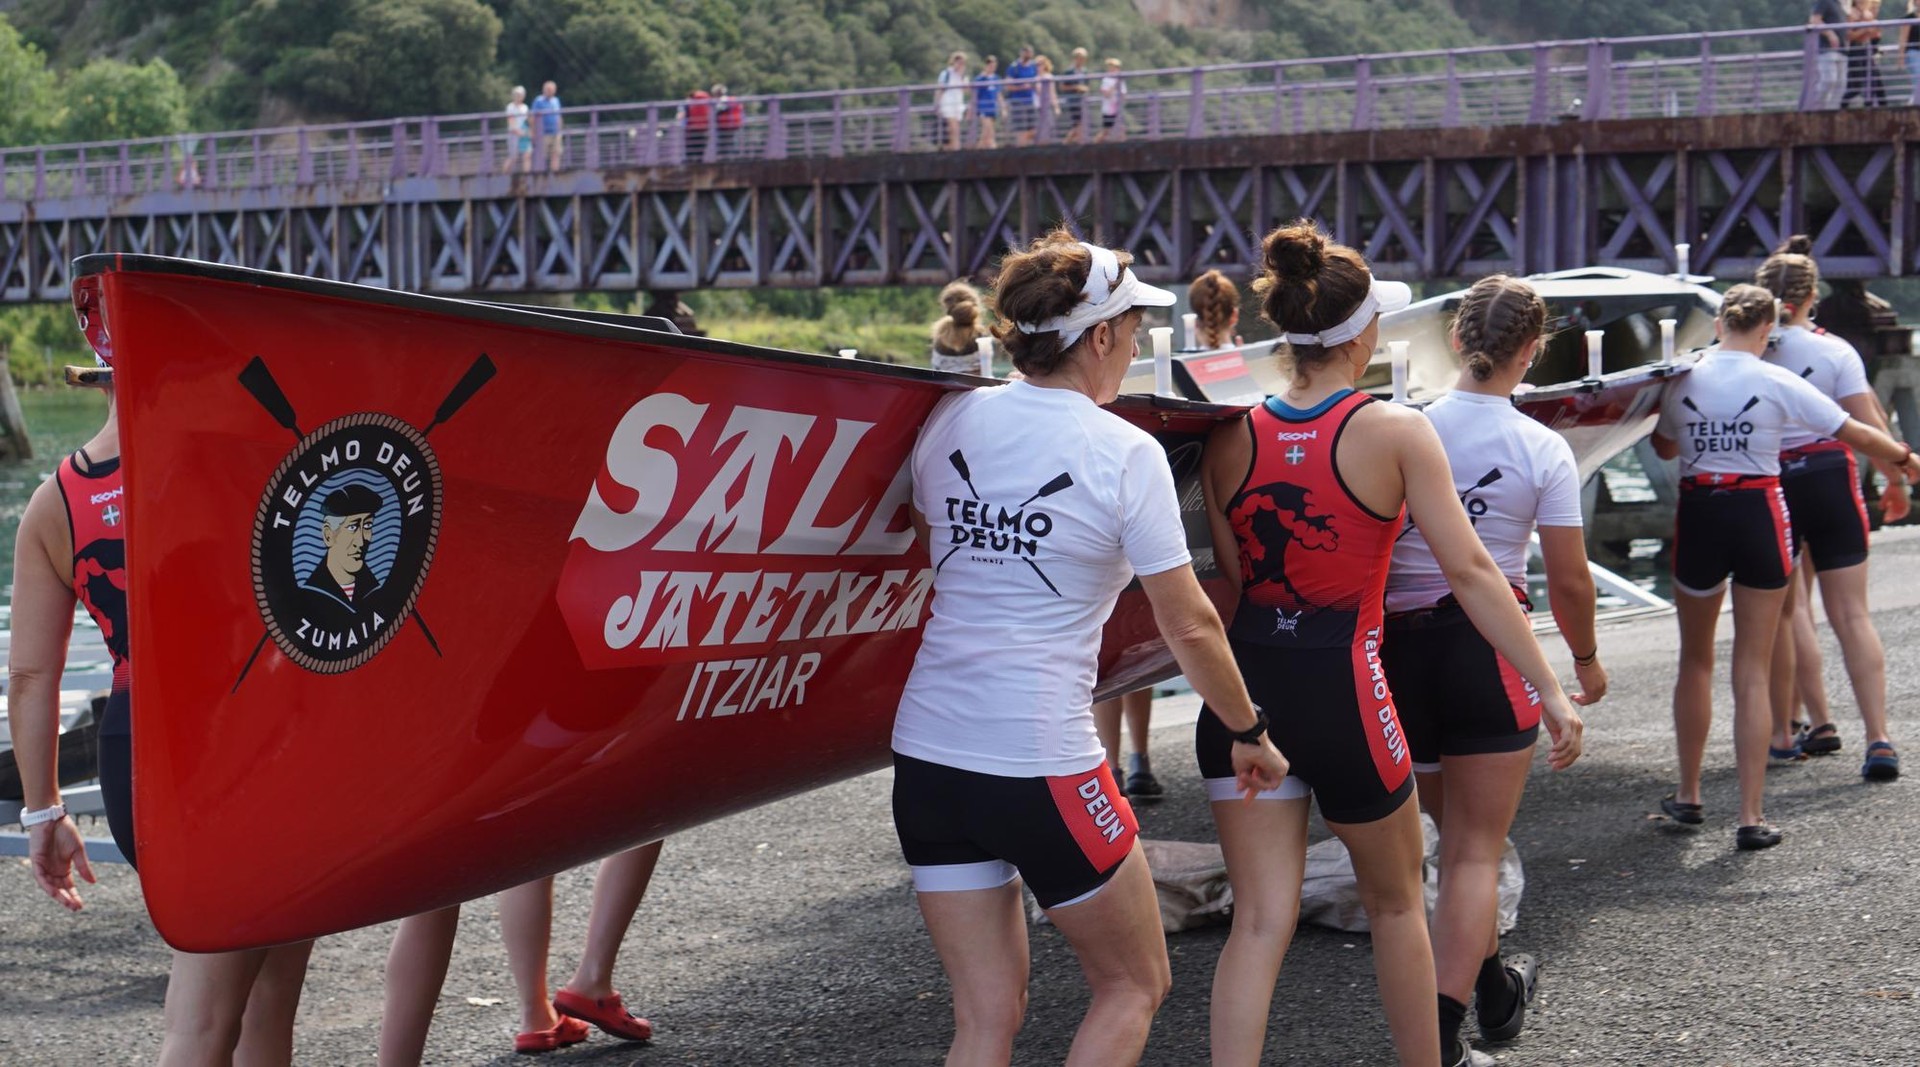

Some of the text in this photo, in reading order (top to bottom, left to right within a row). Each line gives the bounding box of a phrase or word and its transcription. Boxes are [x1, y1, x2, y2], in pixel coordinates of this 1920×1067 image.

[1687, 421, 1754, 437] TELMO
[1695, 437, 1748, 453] DEUN
[273, 440, 424, 529] TELMO DEUN
[945, 497, 1053, 538] TELMO
[950, 524, 1038, 557] DEUN
[296, 611, 385, 650] ZUMAIA
[603, 568, 936, 652] JATETXEA
[1277, 617, 1298, 626] TELMO
[675, 652, 822, 721] ITZIAR
[1364, 626, 1406, 765] TELMO DEUN
[1077, 777, 1126, 844] DEUN
